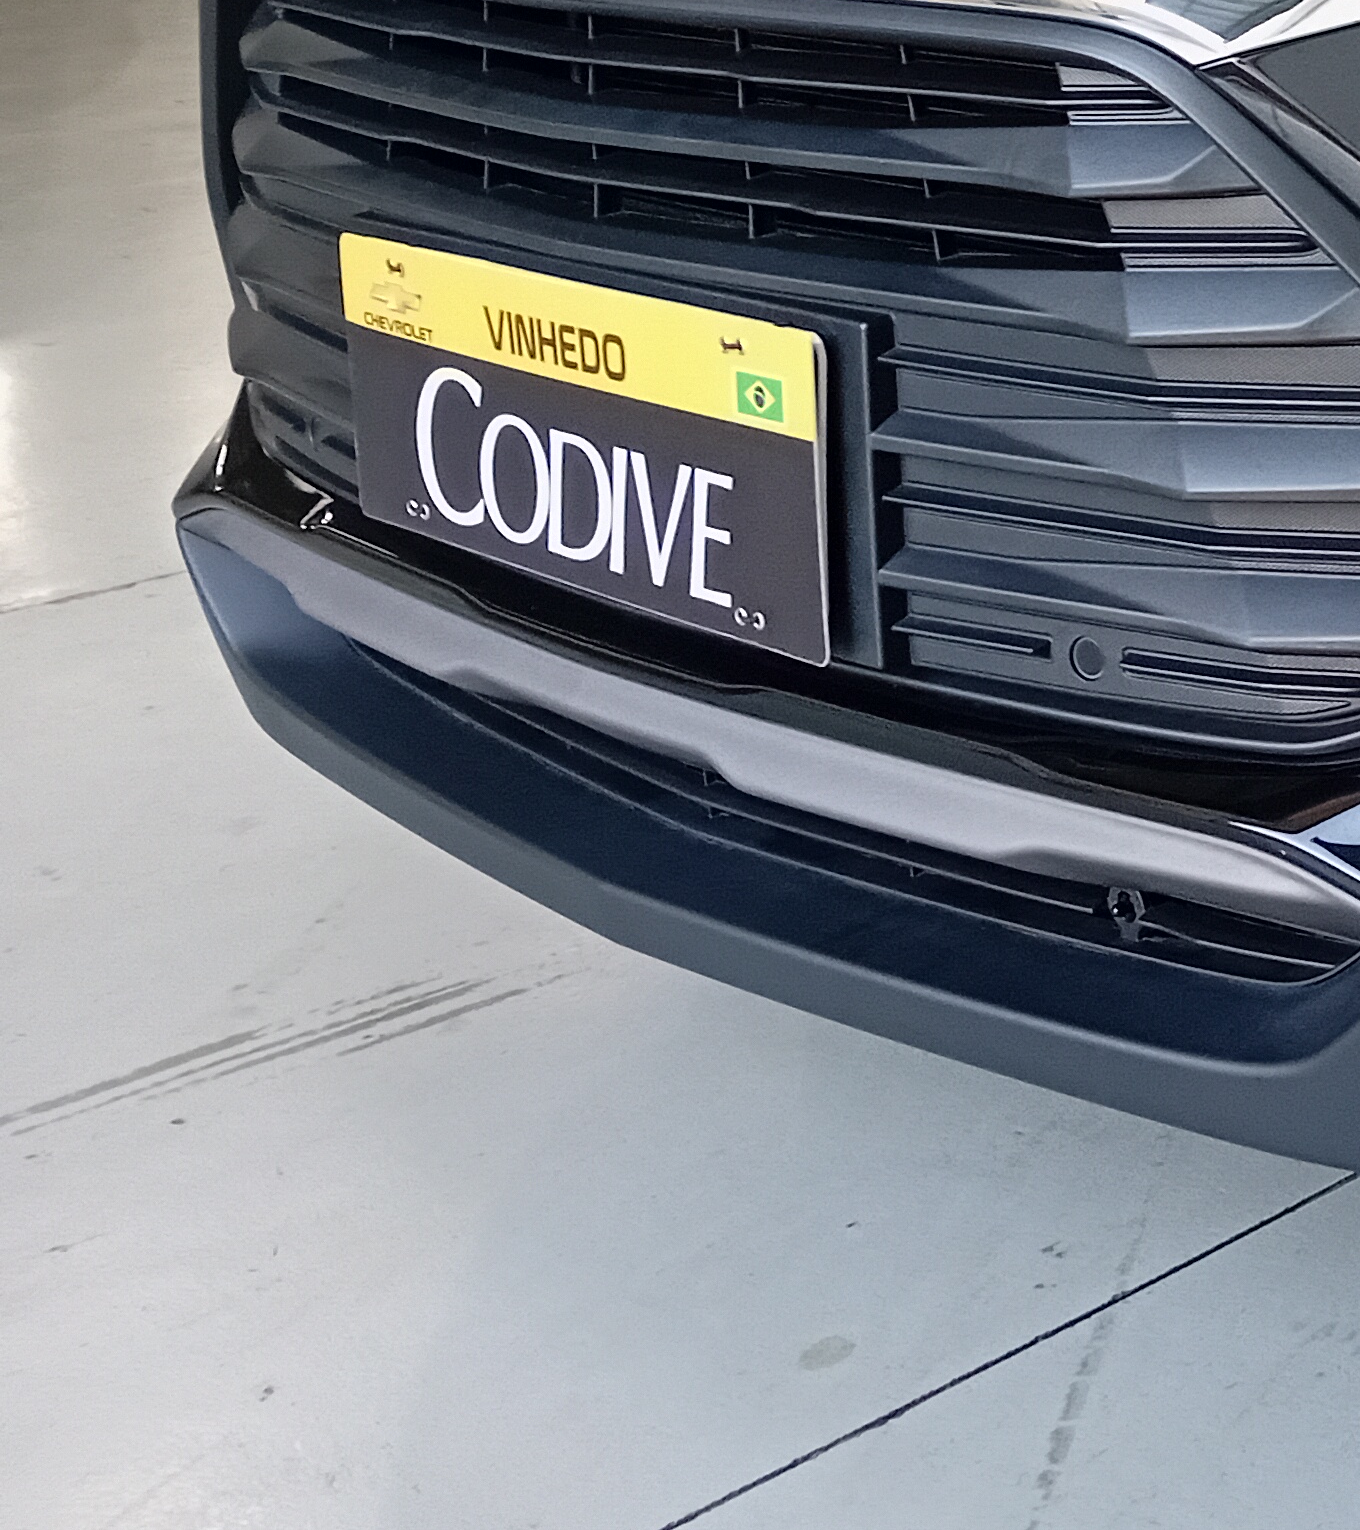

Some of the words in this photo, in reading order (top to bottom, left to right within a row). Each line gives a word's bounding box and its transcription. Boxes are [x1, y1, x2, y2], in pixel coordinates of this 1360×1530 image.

[364, 311, 433, 342] CHEVROLET
[483, 305, 627, 381] VINHEDO
[415, 367, 734, 609] CODIVE
